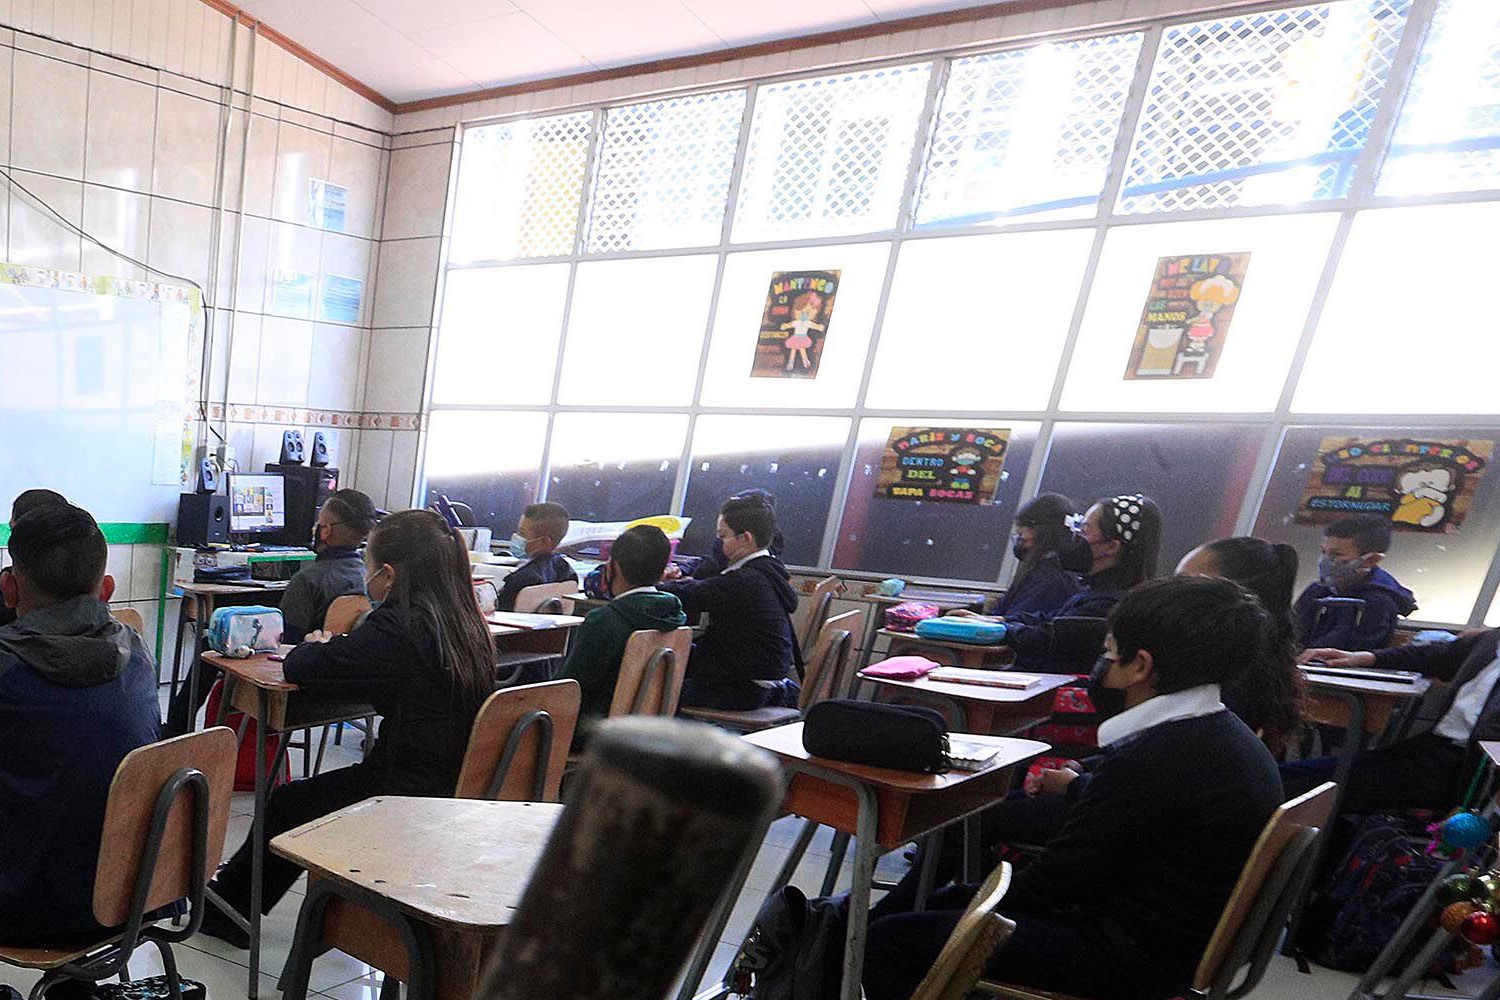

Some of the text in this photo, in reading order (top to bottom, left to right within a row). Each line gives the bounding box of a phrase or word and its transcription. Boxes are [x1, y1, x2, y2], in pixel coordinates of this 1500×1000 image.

[902, 456, 945, 467] DENTRO
[907, 469, 937, 480] DEL
[928, 488, 975, 499] BOCAS
[1309, 498, 1391, 512] ESTORNUDAR
